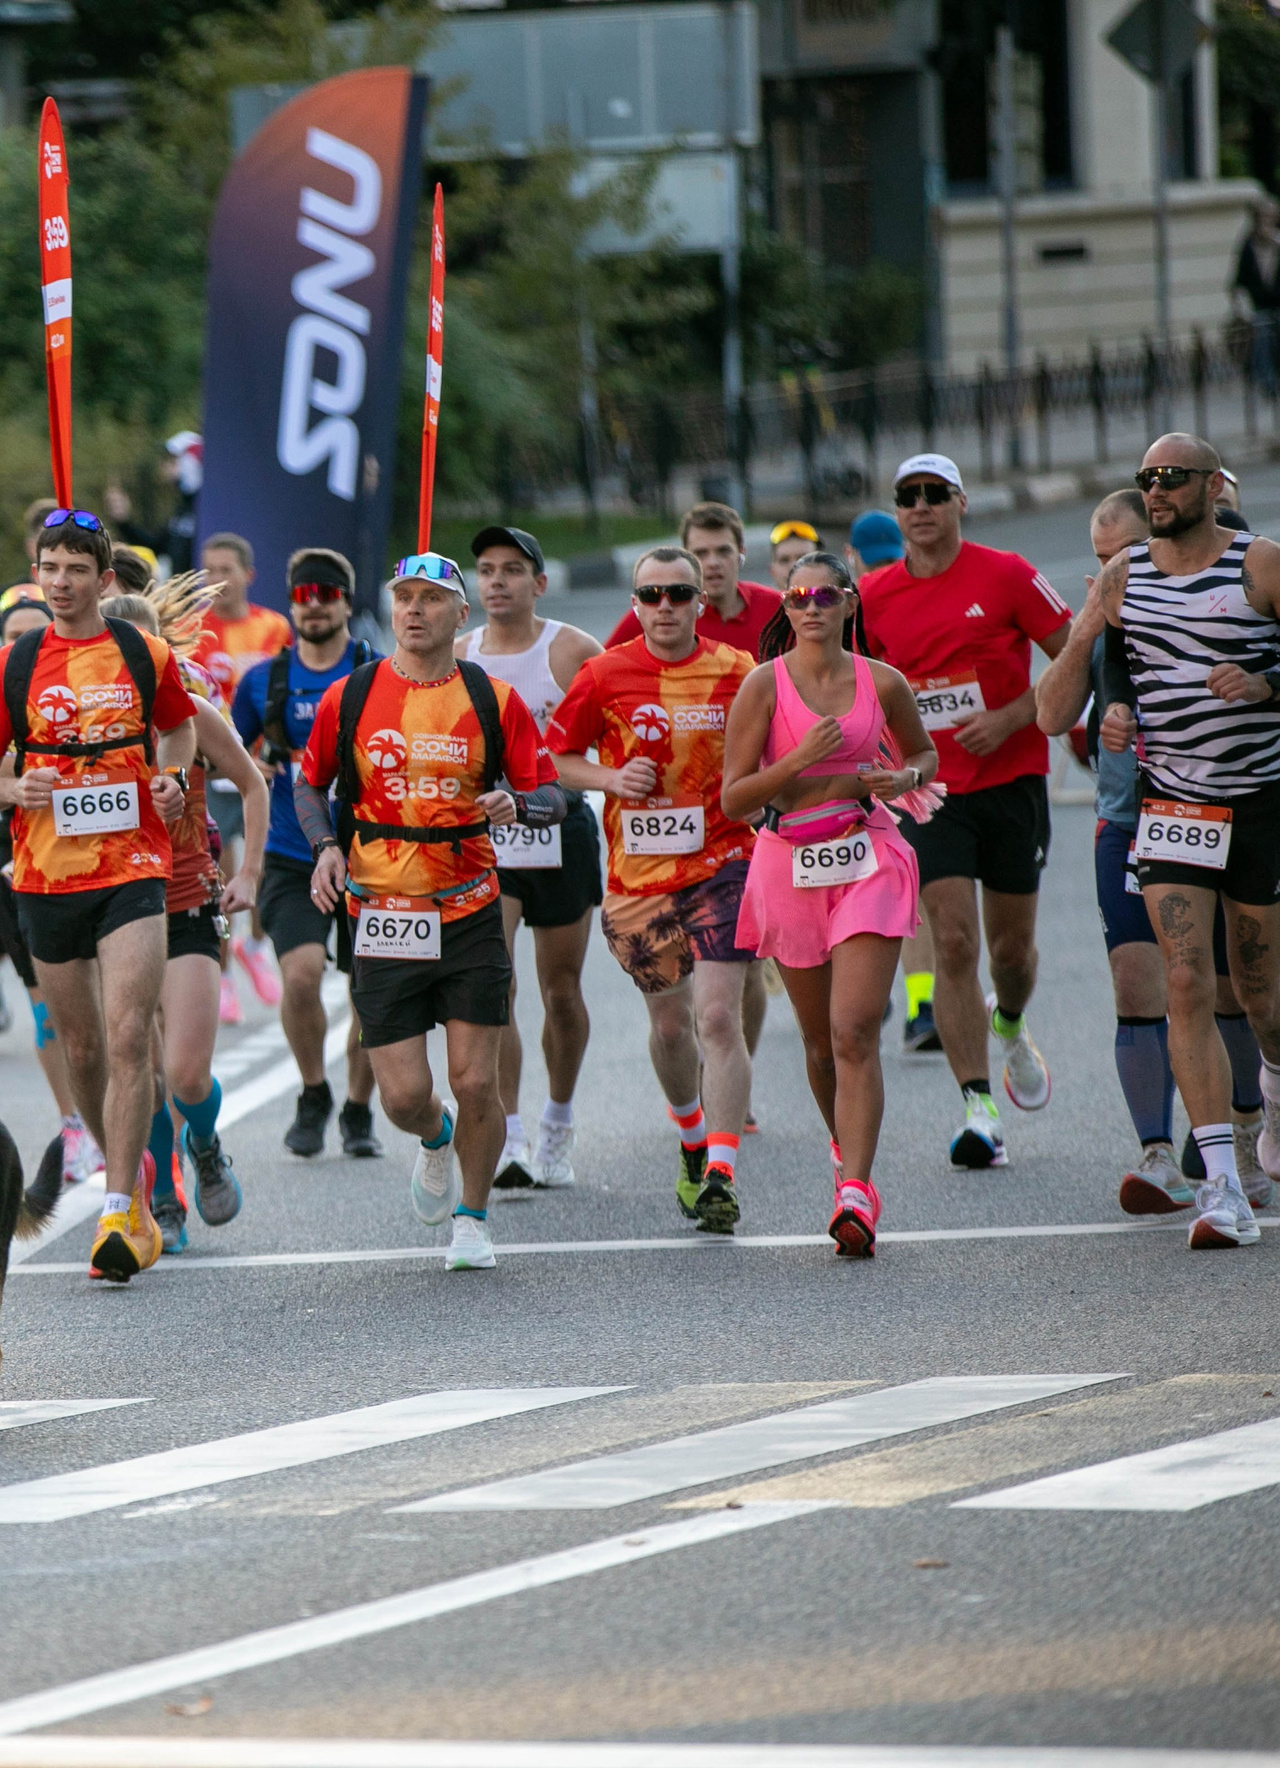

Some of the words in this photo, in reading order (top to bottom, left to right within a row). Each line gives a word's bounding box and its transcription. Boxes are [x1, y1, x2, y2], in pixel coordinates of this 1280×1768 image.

[80, 690, 133, 704] СОЧИ
[673, 711, 725, 723] СОЧИ
[674, 723, 724, 731] МАРАФОН
[413, 733, 468, 743] СОВКОМБАНК
[411, 740, 468, 757] СОЧИ
[411, 753, 467, 765] МАРАФОН
[384, 776, 461, 801] 3:59
[63, 790, 130, 816] 6666
[631, 814, 697, 836] 6824
[493, 826, 552, 845] 6790
[1148, 822, 1221, 849] 6689
[801, 841, 866, 868] 6690
[366, 917, 431, 940] 6670
